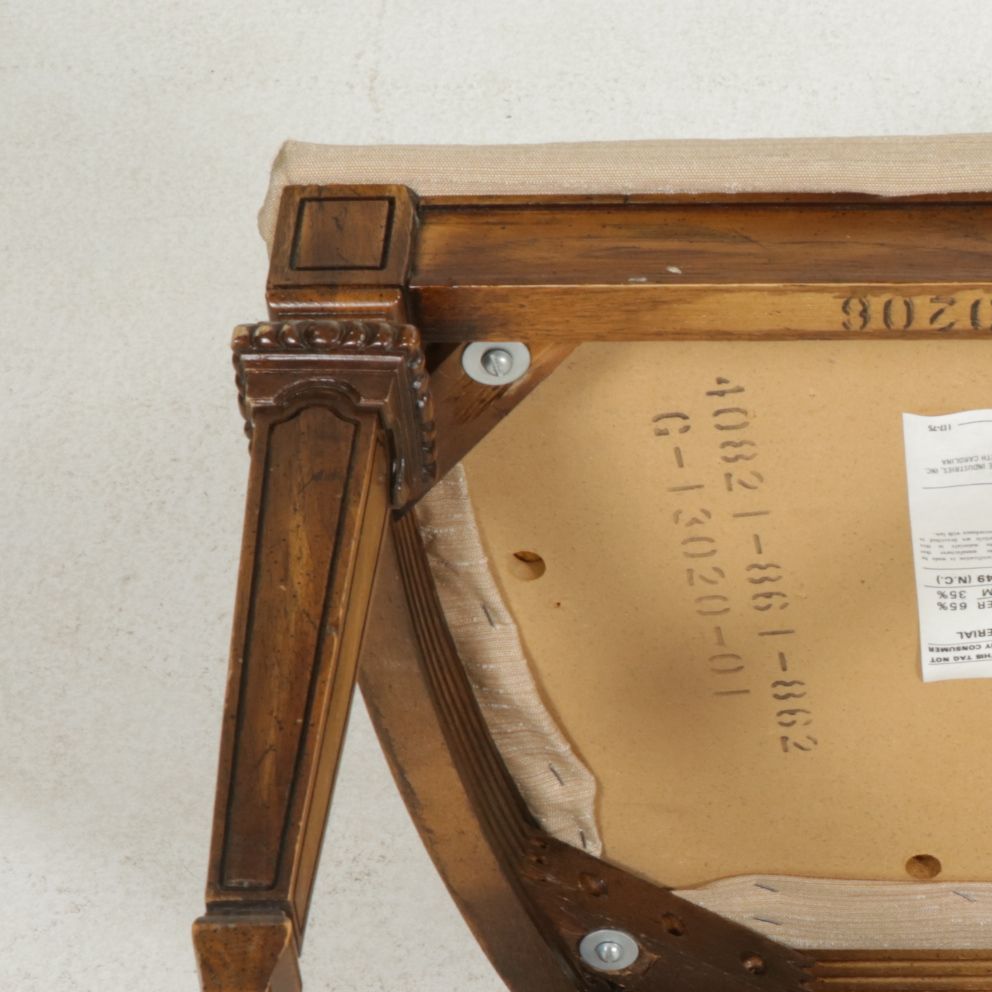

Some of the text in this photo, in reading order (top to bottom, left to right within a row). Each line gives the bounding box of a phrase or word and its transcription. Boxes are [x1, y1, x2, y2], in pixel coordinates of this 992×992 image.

[936, 575, 973, 585] (N.C.)
[937, 590, 968, 600] 35%
[936, 601, 968, 611] 65%
[928, 643, 982, 652] CONSUMER
